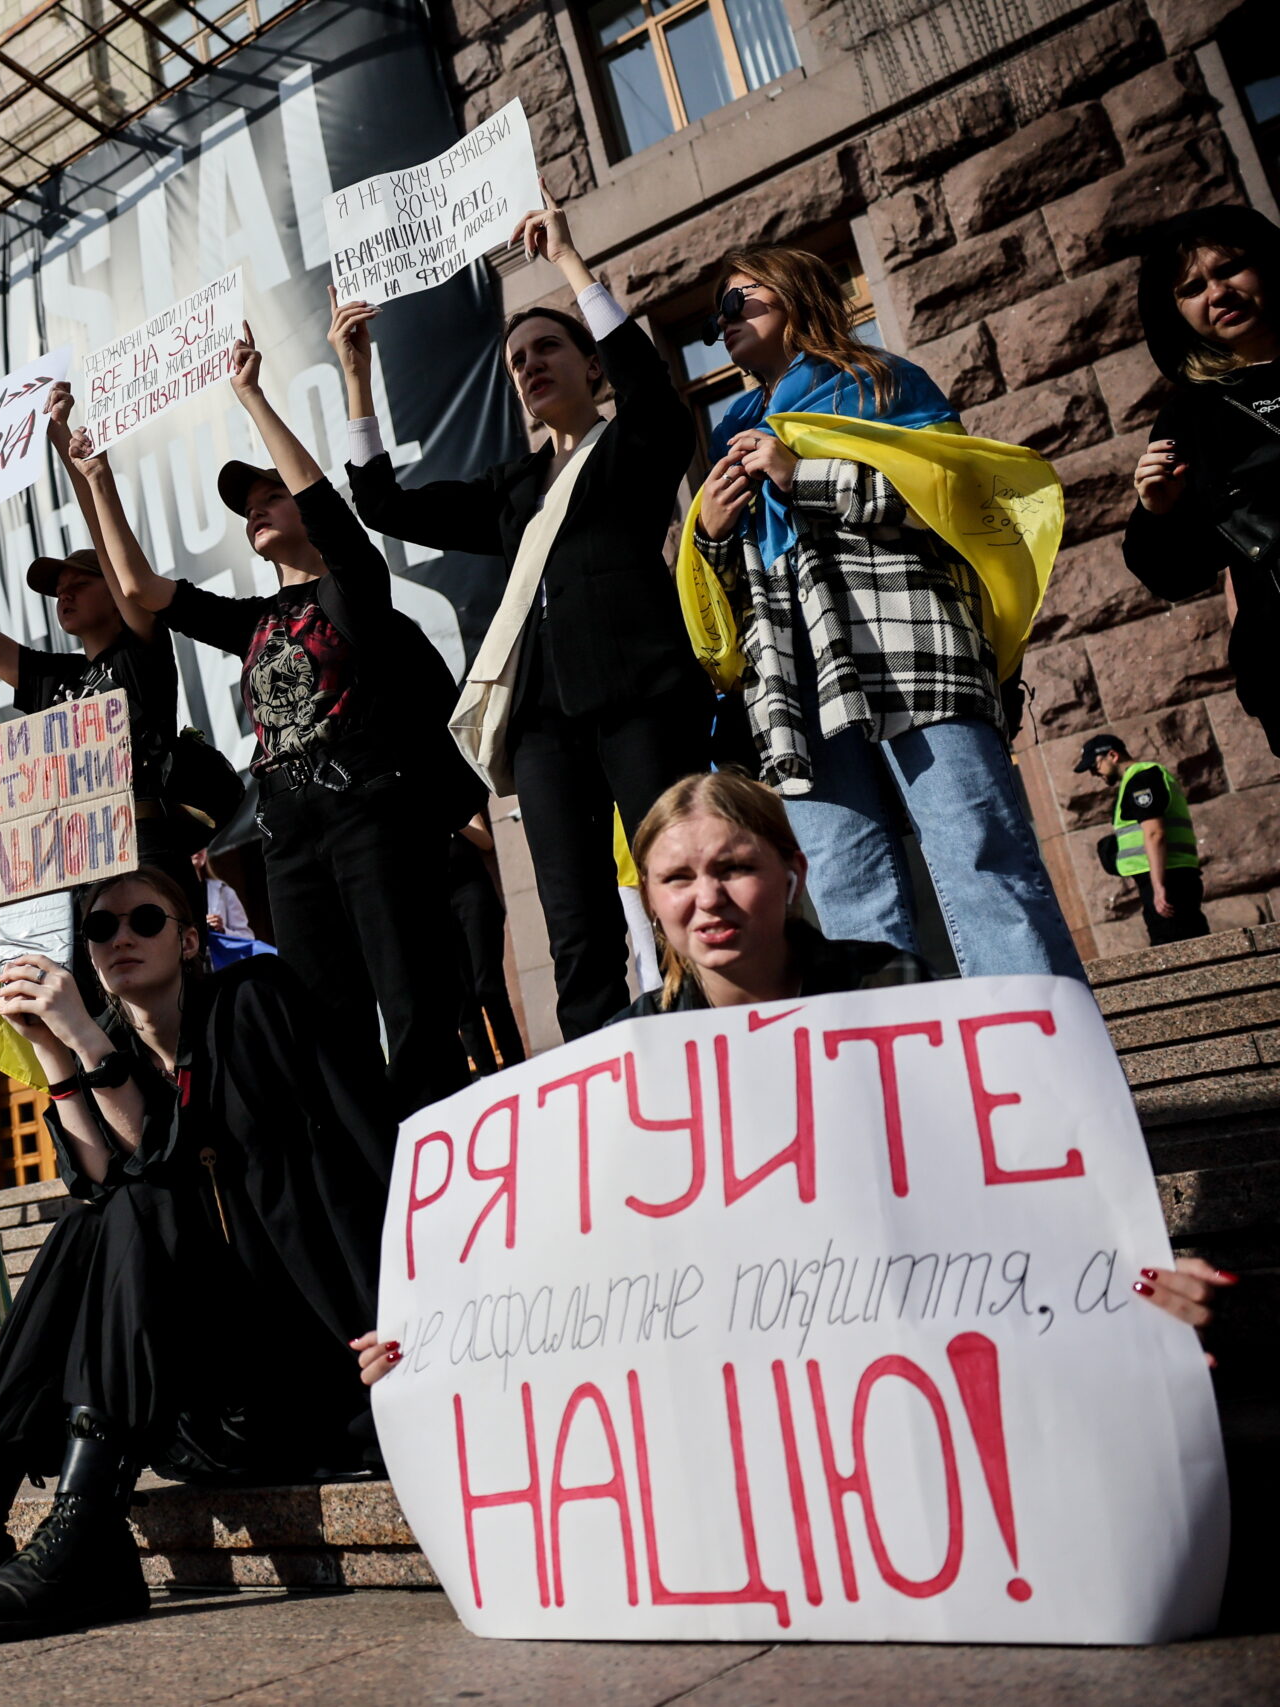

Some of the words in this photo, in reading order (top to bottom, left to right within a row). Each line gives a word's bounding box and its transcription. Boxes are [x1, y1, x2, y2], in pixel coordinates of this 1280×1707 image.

[336, 194, 348, 219] Я
[358, 178, 383, 210] НЕ
[390, 166, 431, 197] ХОЧУ
[438, 114, 511, 180] БРУКІВКИ
[397, 183, 447, 222] ХОЧУ
[334, 215, 443, 276] ЕВАКУАЦІЙНІ
[452, 180, 494, 227] АВТО
[338, 277, 360, 300] ЯКІ
[363, 253, 417, 288] РЯТУЮТЬ
[464, 197, 508, 243] ЛЮДЕЙ
[384, 278, 401, 298] НА
[416, 249, 467, 286] ФРОНТІ
[85, 329, 142, 377] ДЕРЖАВНІ
[184, 273, 237, 316] ПОДАТКИ
[91, 362, 122, 403] ВСЕ
[134, 343, 159, 377] НА
[168, 304, 214, 356] ЗСУ!
[97, 416, 112, 446] НЕ
[116, 379, 180, 434] БЕЗГЛУЗДІ
[404, 1004, 1086, 1281] РЯТУЙТЕ
[449, 1264, 705, 1392] асфальтне
[1073, 1245, 1130, 1317] а
[452, 1330, 1034, 1629] НАЦІЮ!
